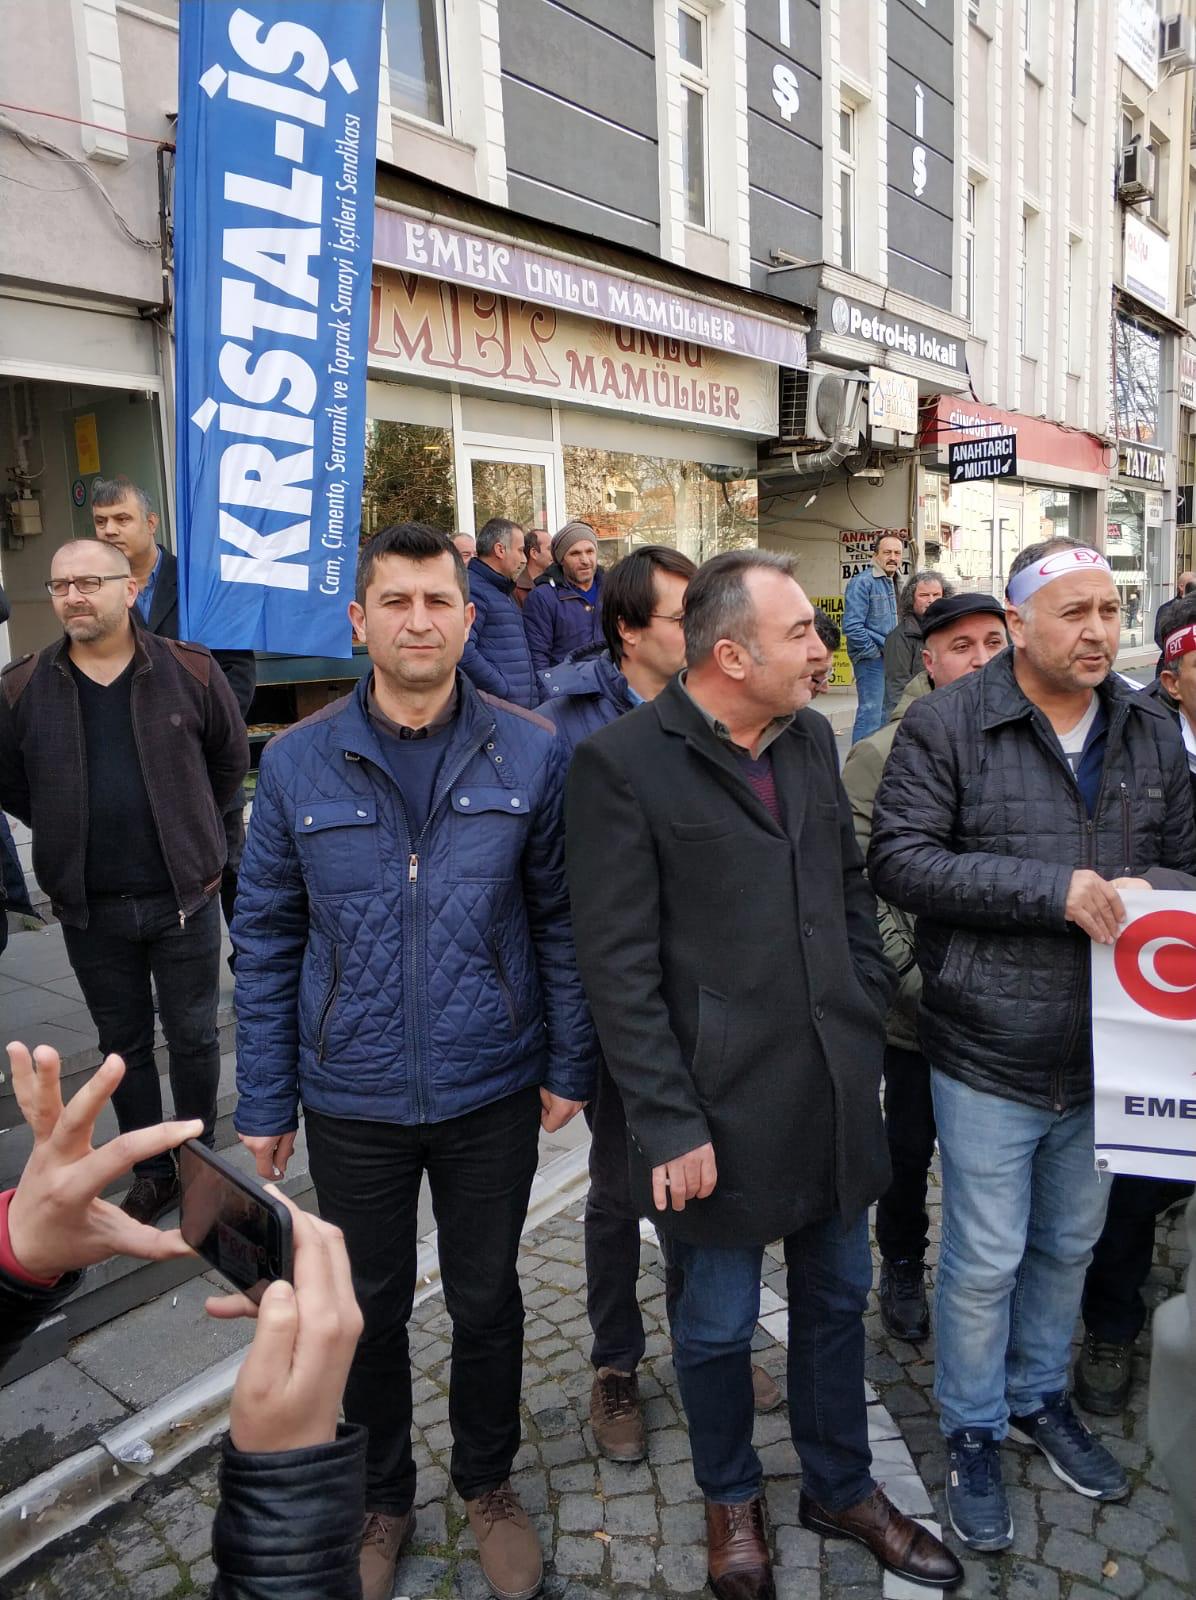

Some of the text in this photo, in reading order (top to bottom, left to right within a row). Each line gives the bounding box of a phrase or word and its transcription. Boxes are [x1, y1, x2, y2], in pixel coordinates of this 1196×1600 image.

[191, 7, 358, 592] KRİSTAL-İŞ
[403, 221, 737, 346] EMEK UNLU MAMÜLLER
[319, 113, 361, 595] Cam, Çimento, Seramik ve Toprak Sanayi İşçileri Sendikası
[566, 349, 741, 421] MAMÜLLER
[919, 332, 957, 367] lokali
[952, 438, 1013, 462] ANAHTARCI
[964, 459, 1001, 479] MUTLU
